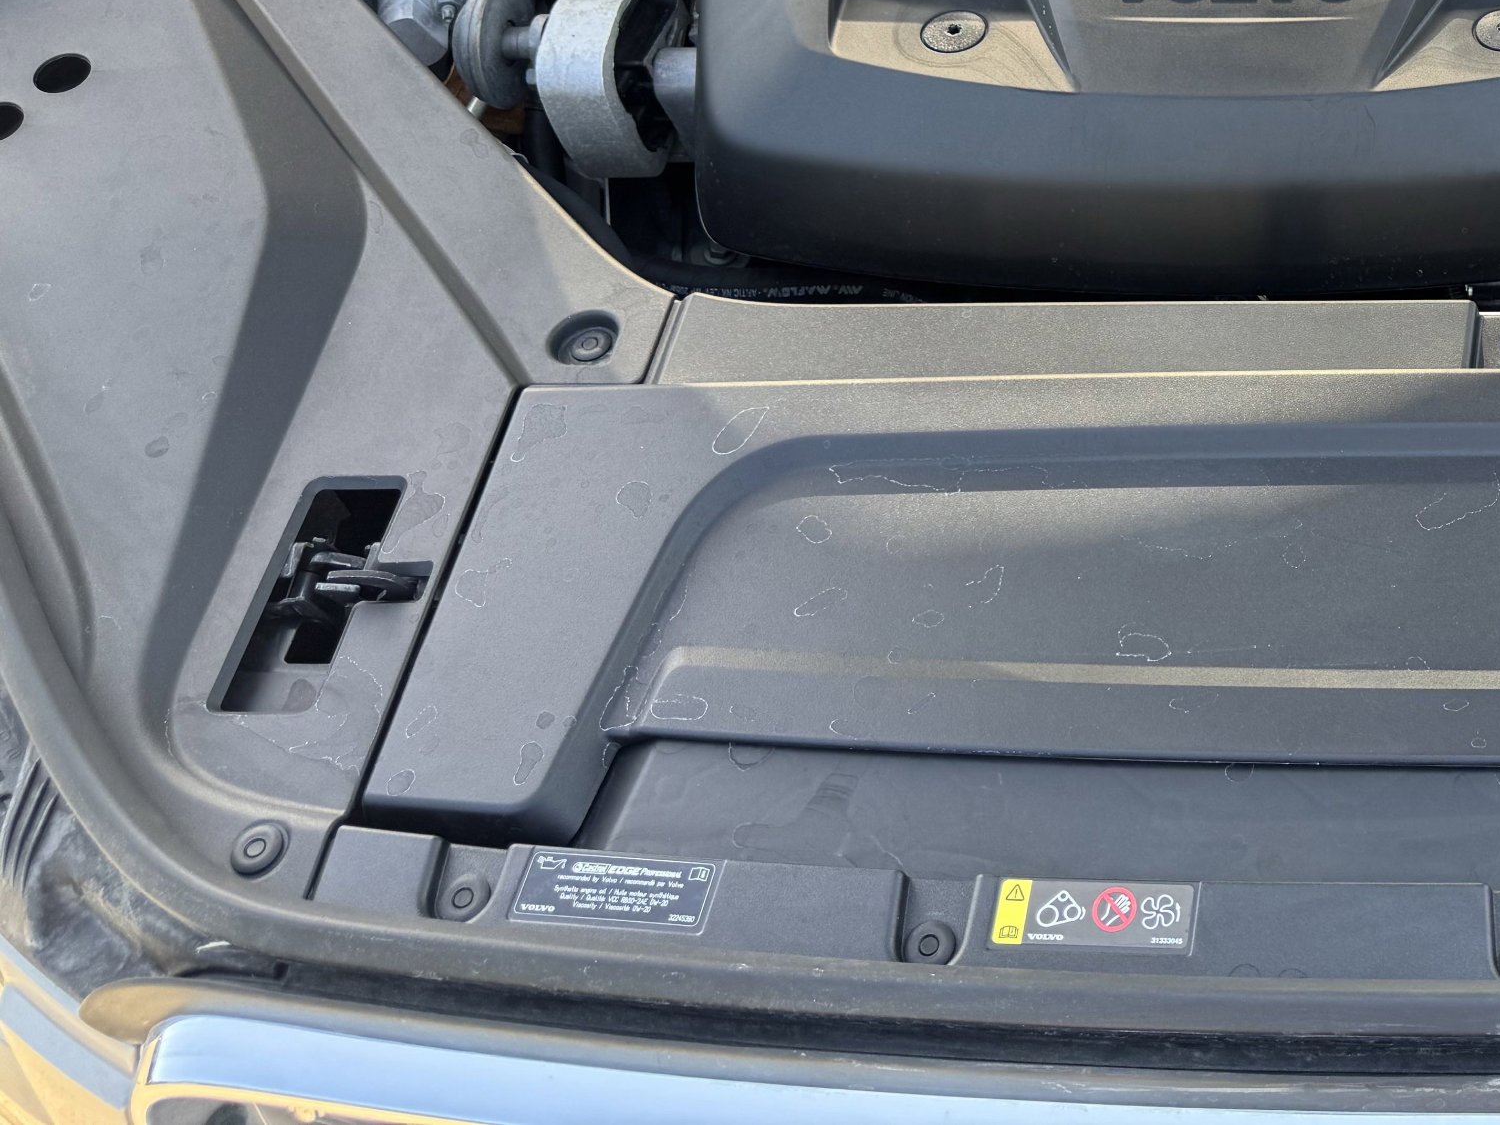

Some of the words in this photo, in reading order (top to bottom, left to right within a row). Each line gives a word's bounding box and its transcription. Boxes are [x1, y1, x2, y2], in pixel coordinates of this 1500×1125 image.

[608, 865, 642, 876] EDGE
[592, 875, 600, 883] by
[602, 876, 618, 884] Volvo
[668, 881, 685, 889] Volvo
[520, 903, 556, 913] VOLVO
[1027, 933, 1064, 941] VOLVO
